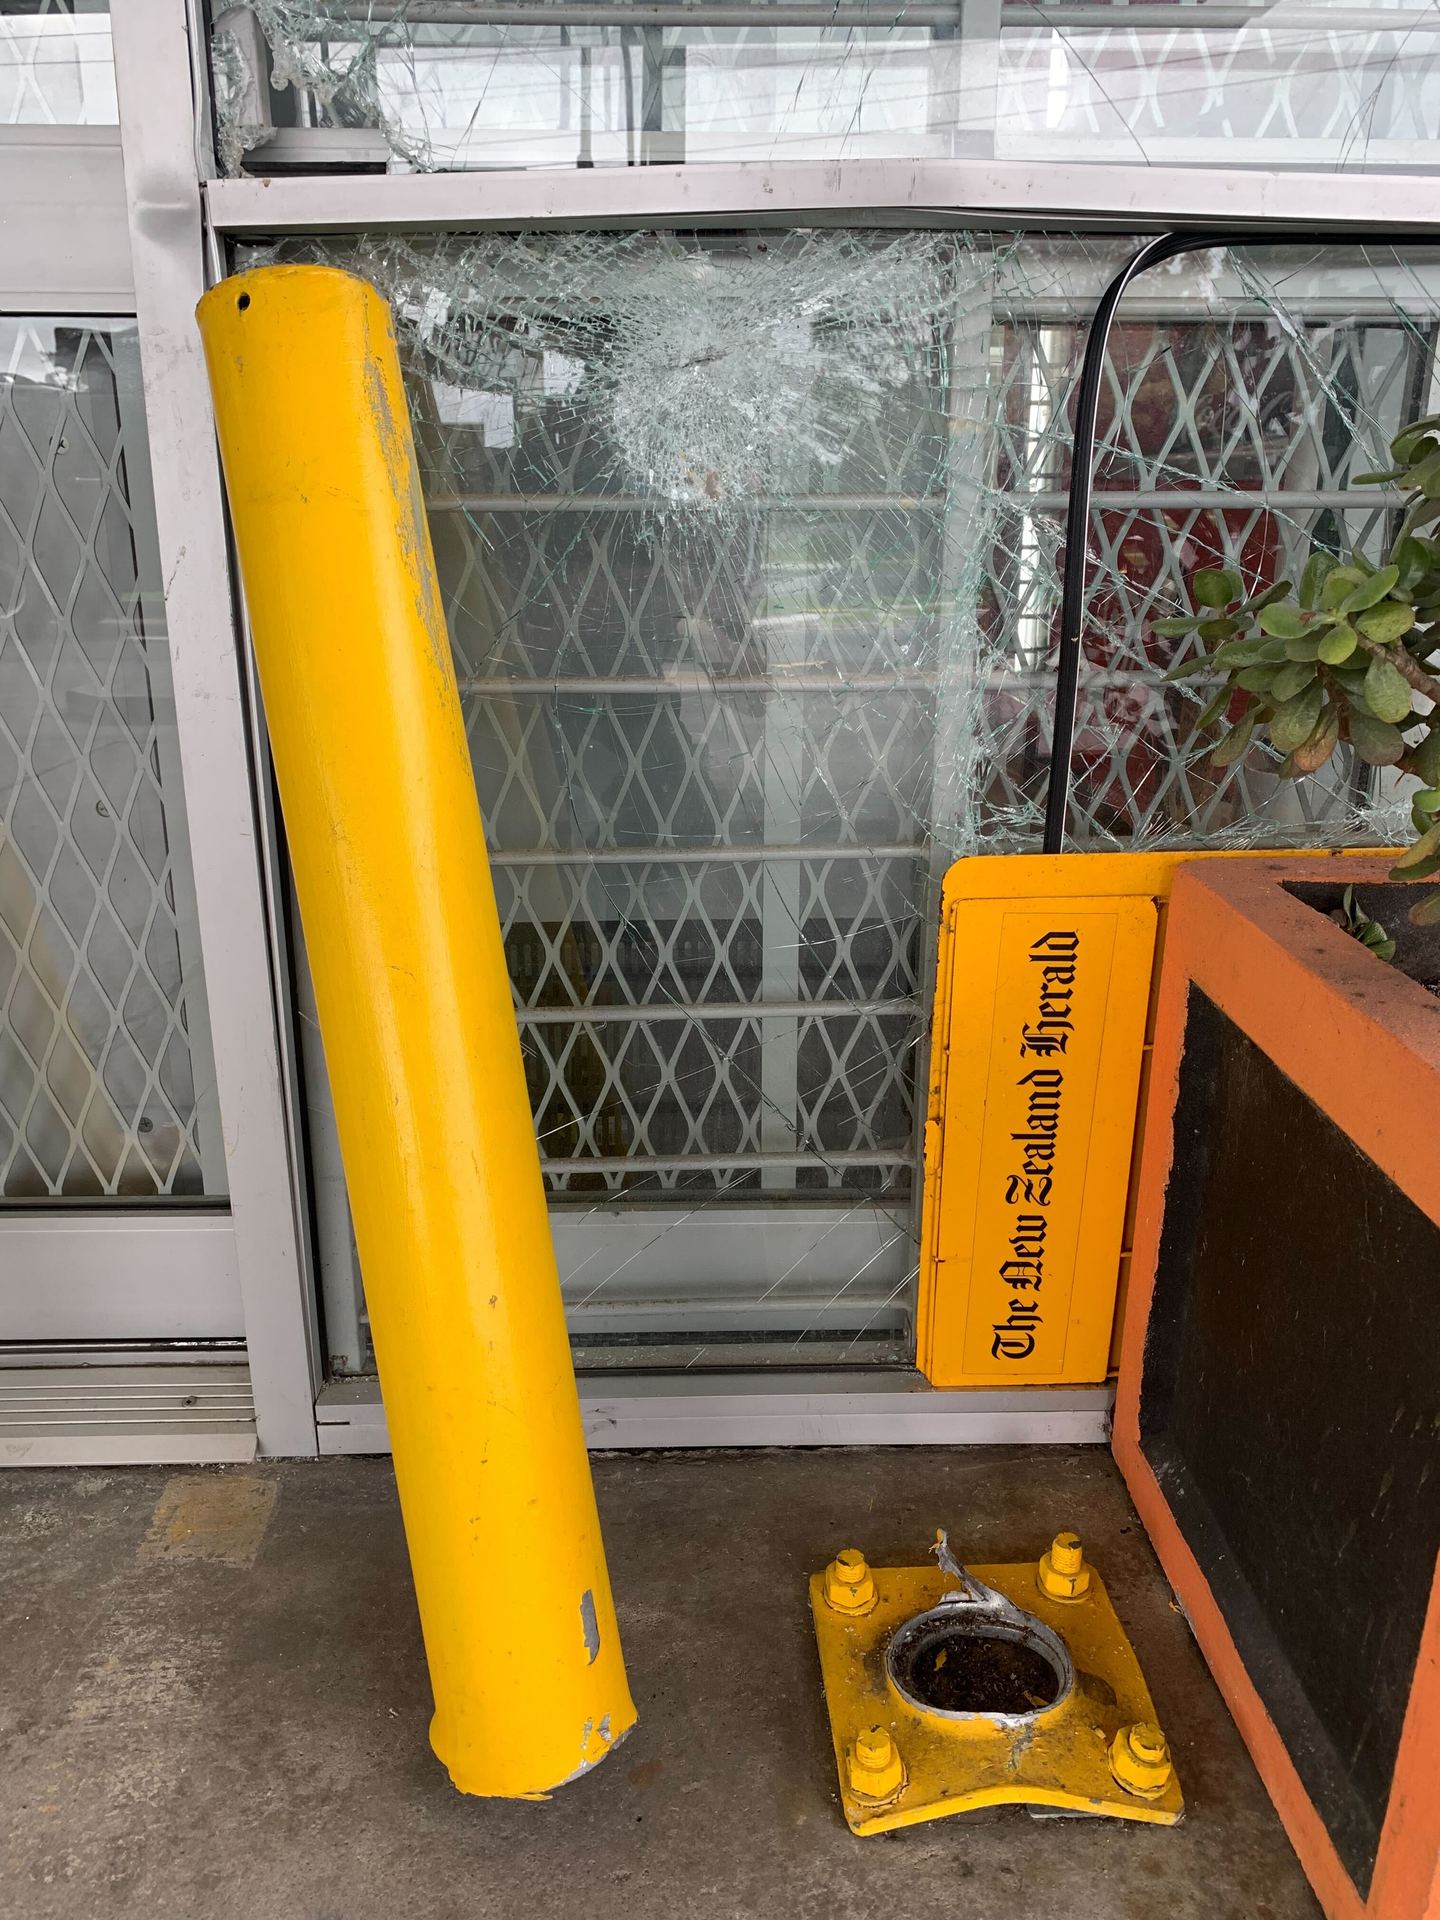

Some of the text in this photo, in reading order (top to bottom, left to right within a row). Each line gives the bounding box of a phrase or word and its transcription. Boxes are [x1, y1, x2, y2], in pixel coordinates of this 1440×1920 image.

[991, 929, 1081, 1360] The New Zealand Herald
